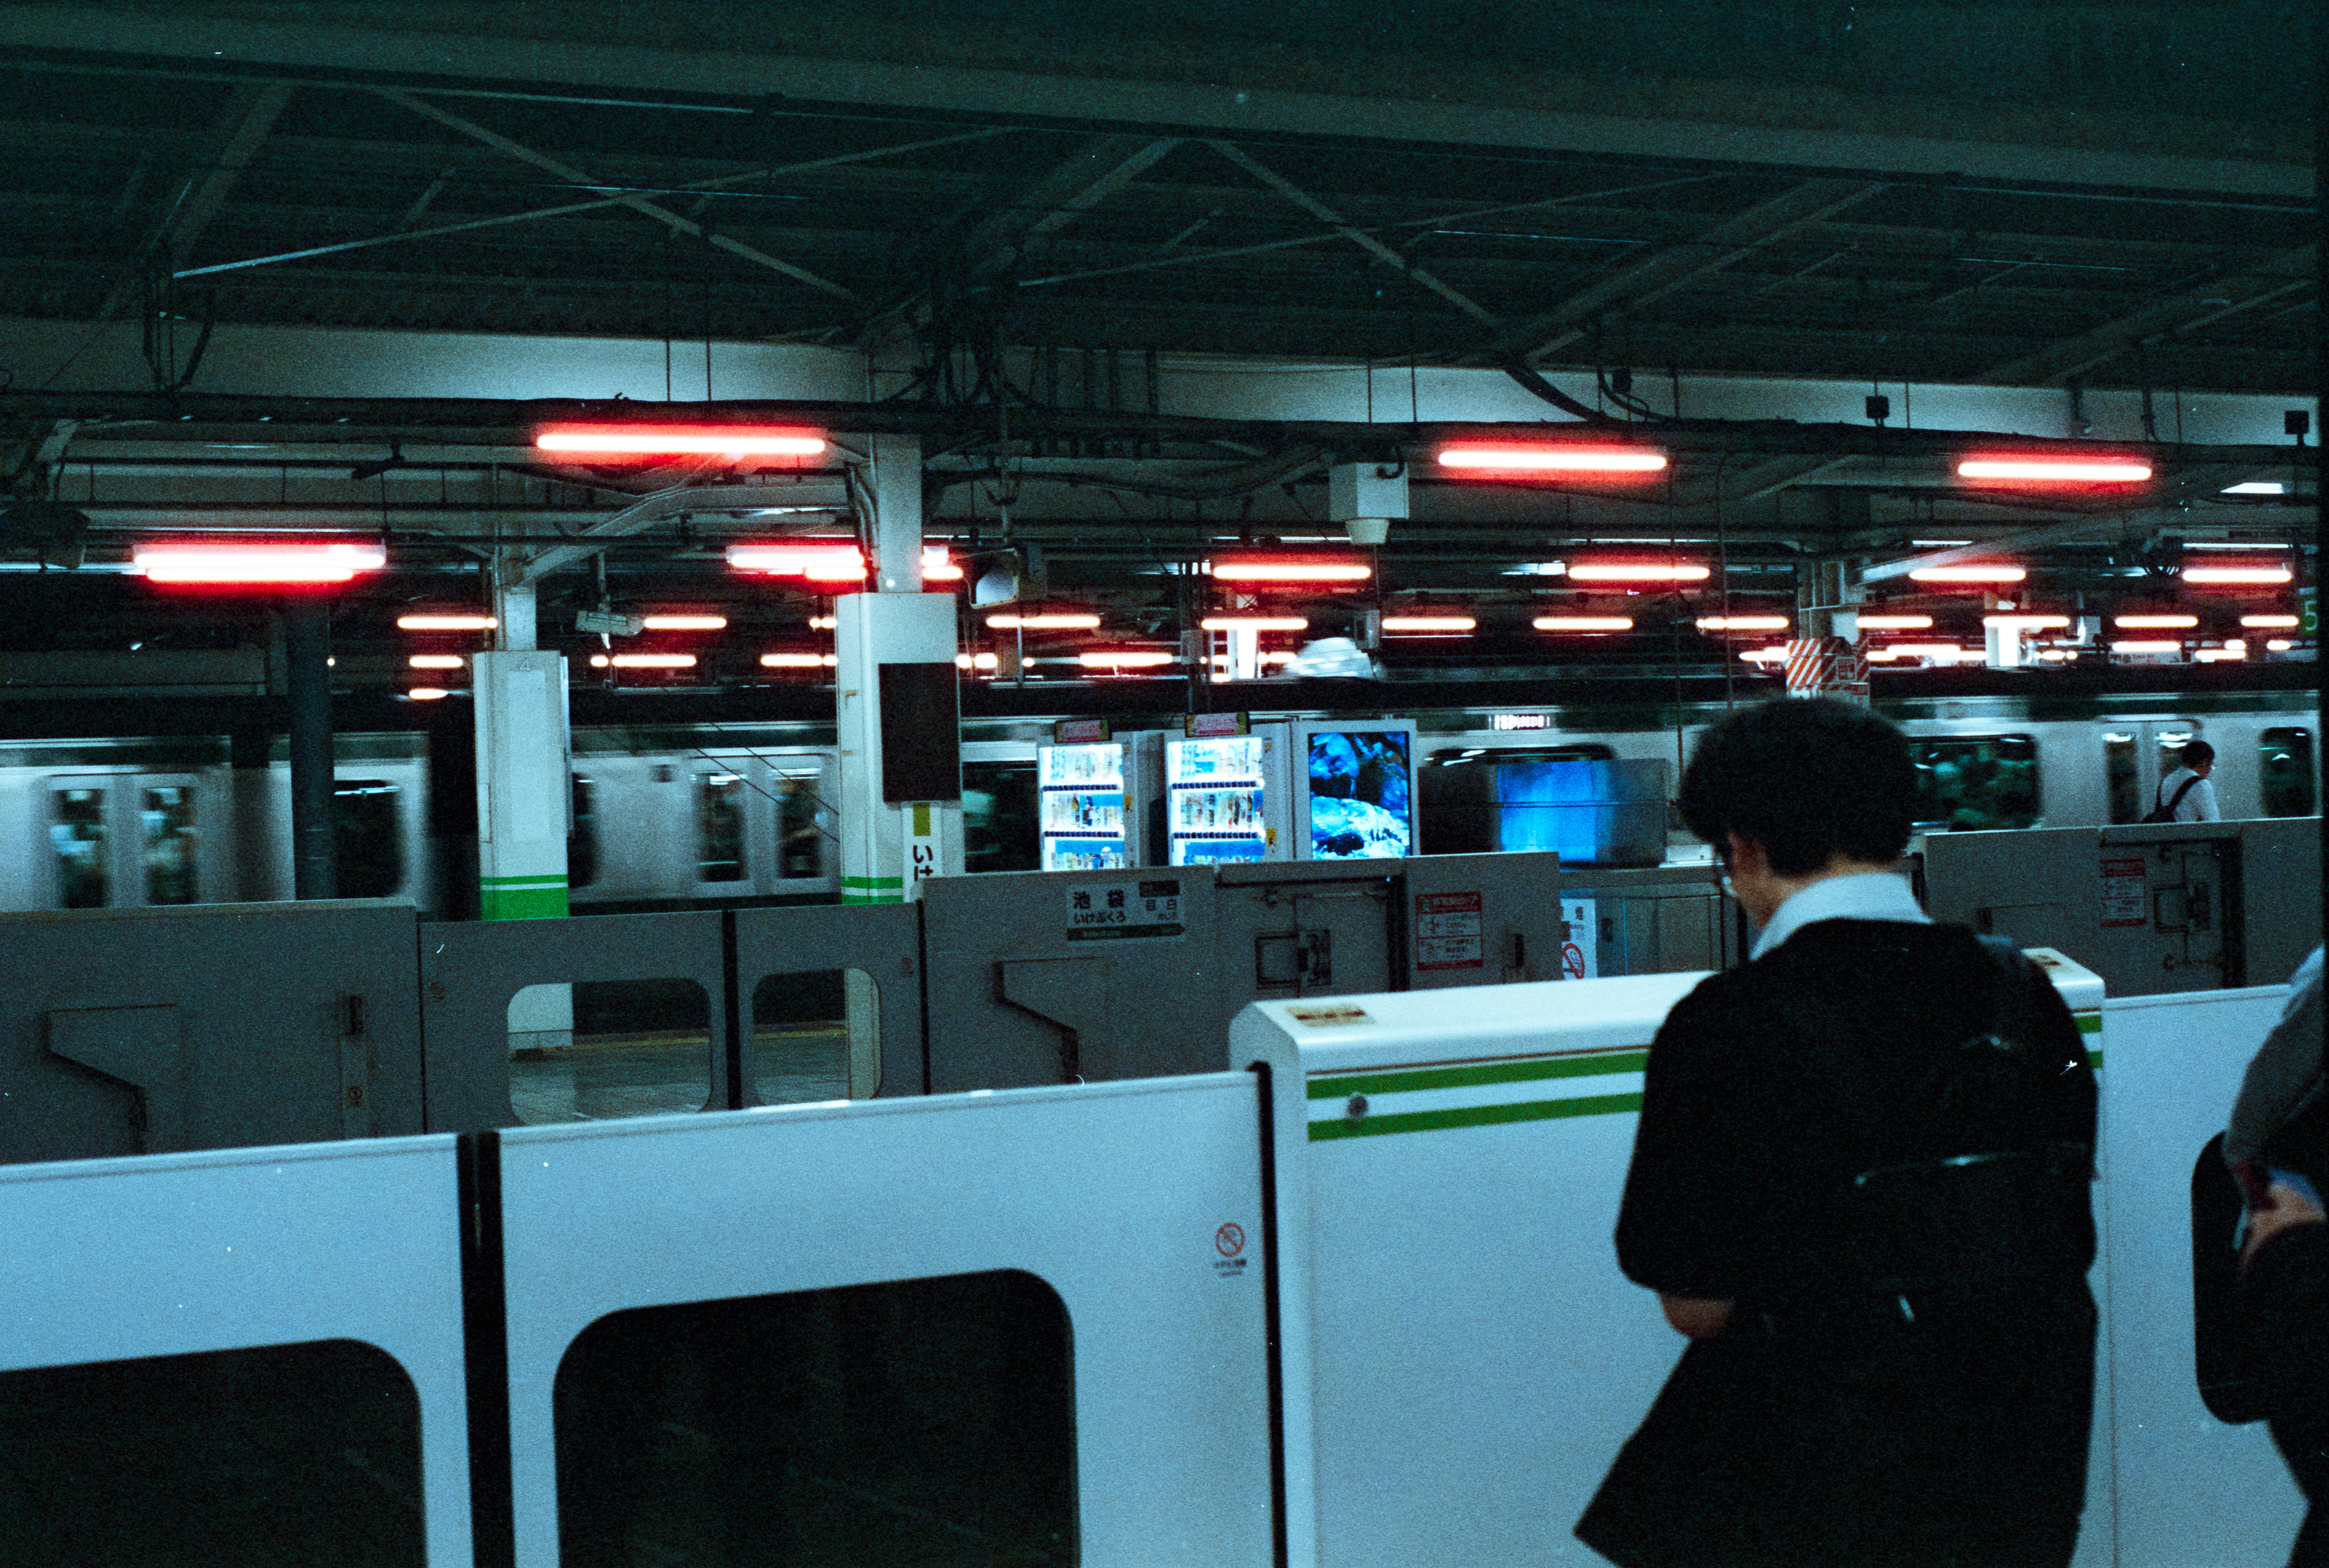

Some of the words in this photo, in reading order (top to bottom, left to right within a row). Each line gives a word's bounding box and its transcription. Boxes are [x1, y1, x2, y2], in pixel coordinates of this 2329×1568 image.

[2305, 600, 2317, 631] 5
[1074, 889, 1124, 909] 池袋
[1146, 899, 1177, 911] 目白
[1074, 911, 1126, 924] いけぶくろ
